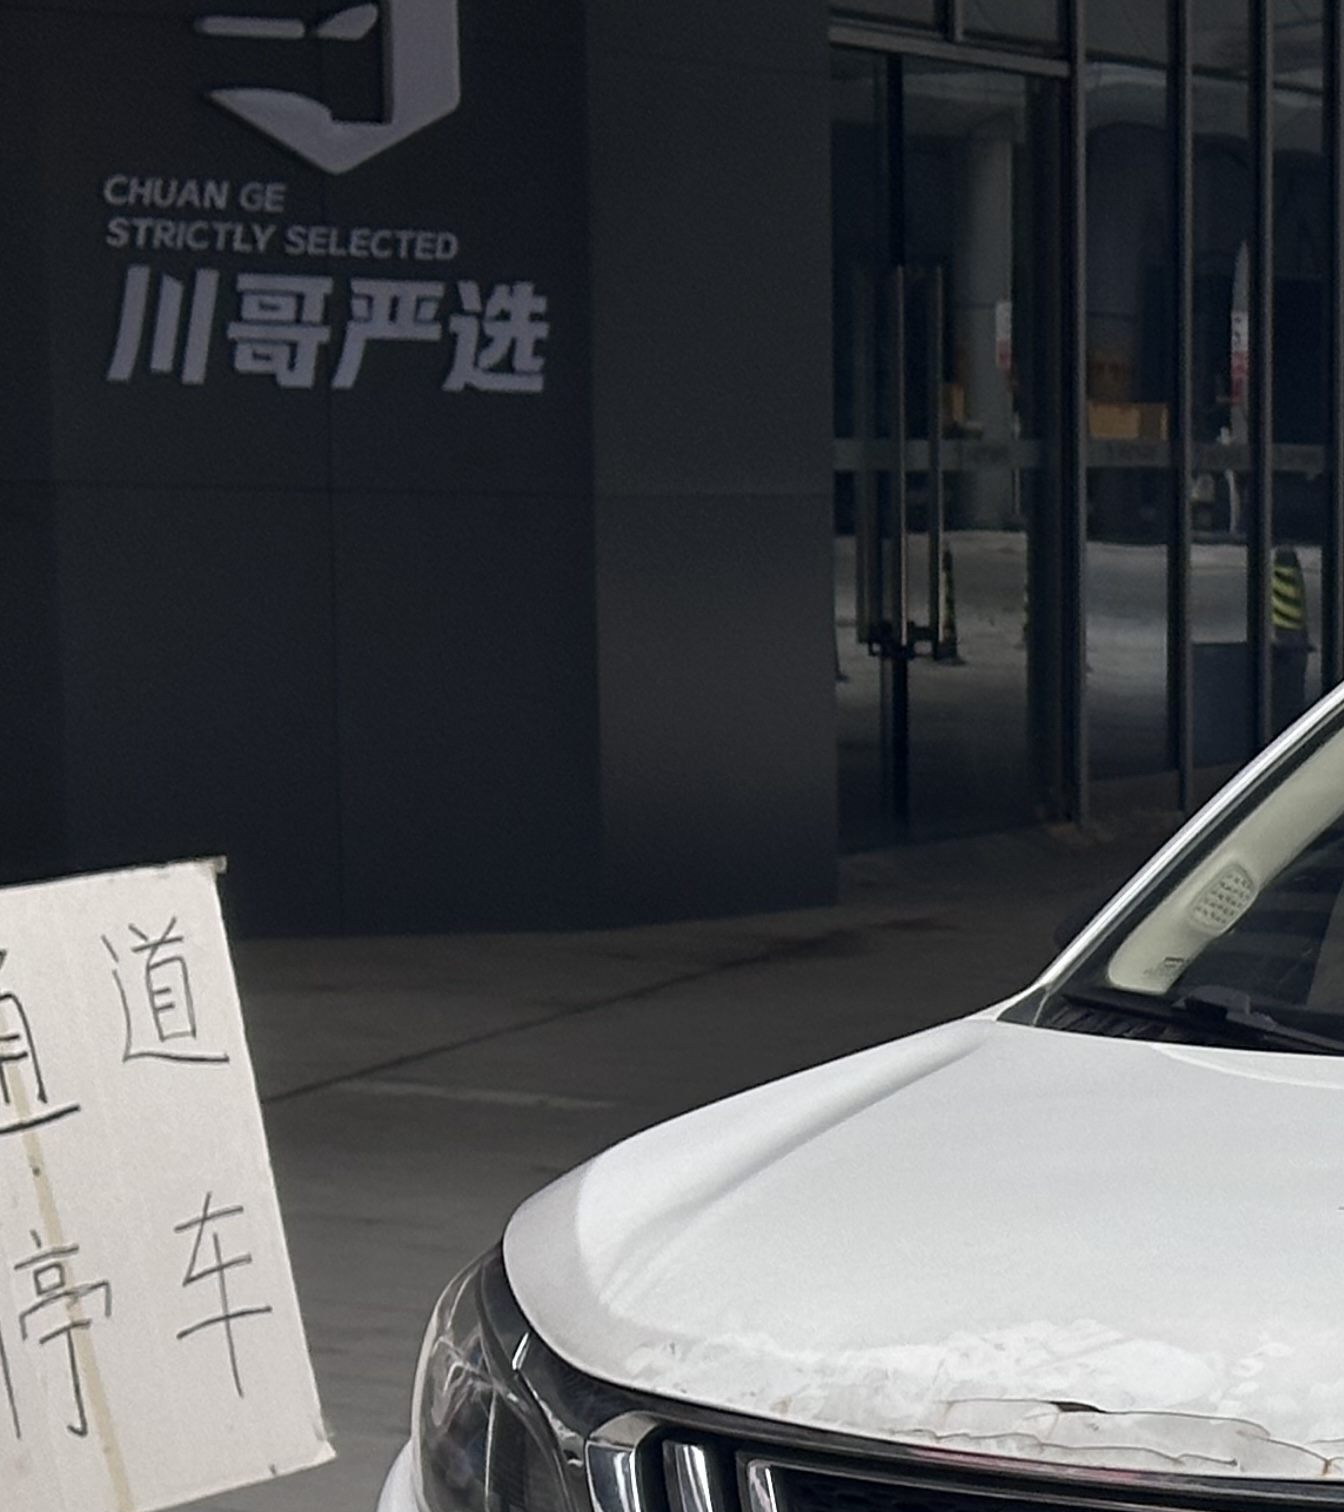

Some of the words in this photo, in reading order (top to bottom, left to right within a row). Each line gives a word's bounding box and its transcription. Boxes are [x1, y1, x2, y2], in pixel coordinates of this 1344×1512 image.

[103, 173, 229, 211] CHUAN
[238, 180, 289, 214] GE
[105, 218, 276, 255] STRICTLY
[284, 226, 459, 262] SELECTED
[106, 264, 551, 393] 川哥严选
